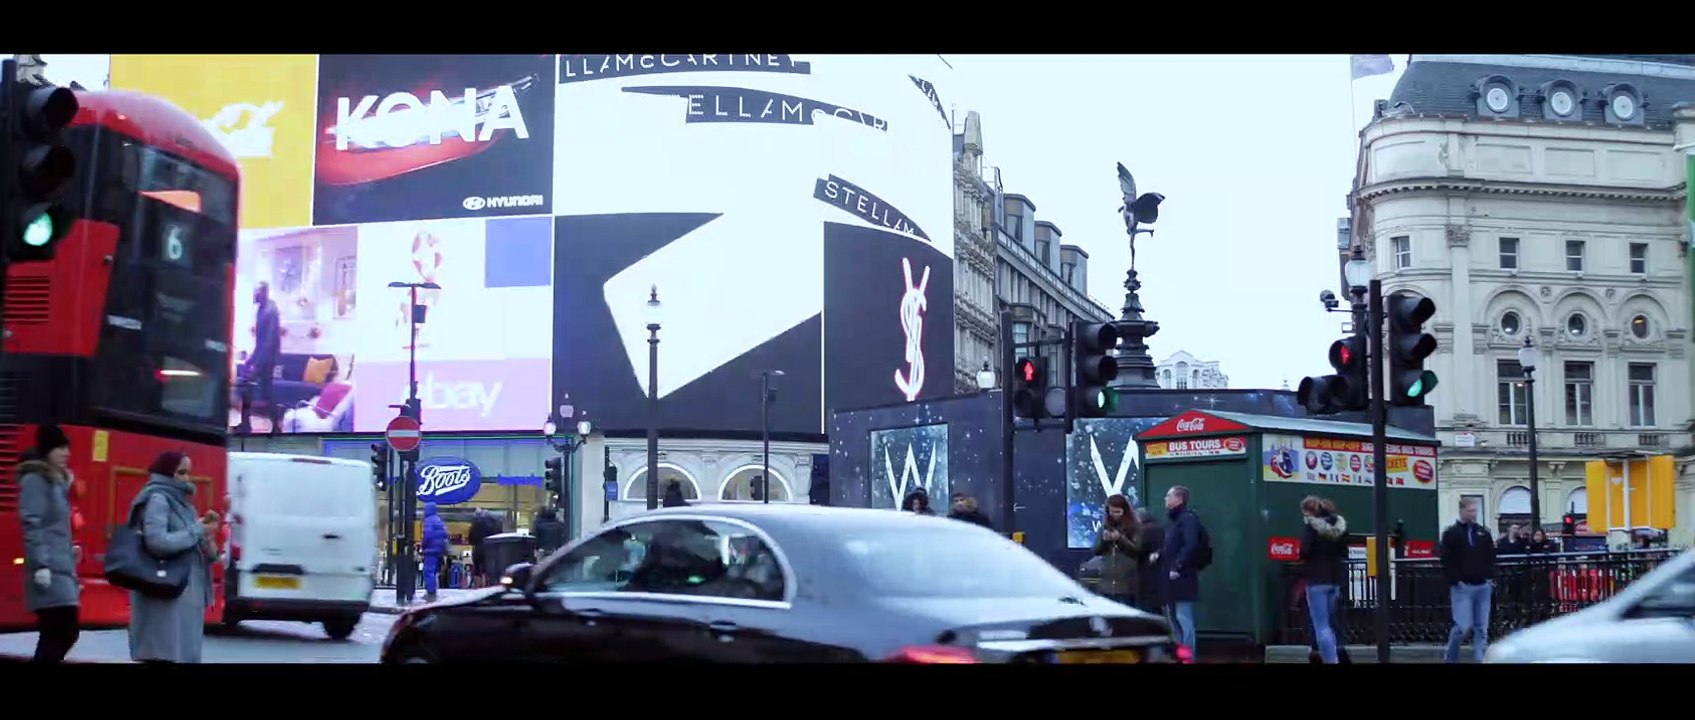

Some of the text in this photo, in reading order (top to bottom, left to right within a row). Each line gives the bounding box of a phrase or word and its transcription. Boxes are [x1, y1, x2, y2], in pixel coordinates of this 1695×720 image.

[336, 85, 530, 151] KONA
[487, 195, 544, 208] HYUNDAI
[167, 226, 183, 259] 6
[1169, 441, 1188, 451] BUS
[1189, 439, 1221, 450] TOURS
[415, 464, 472, 496] Boots
